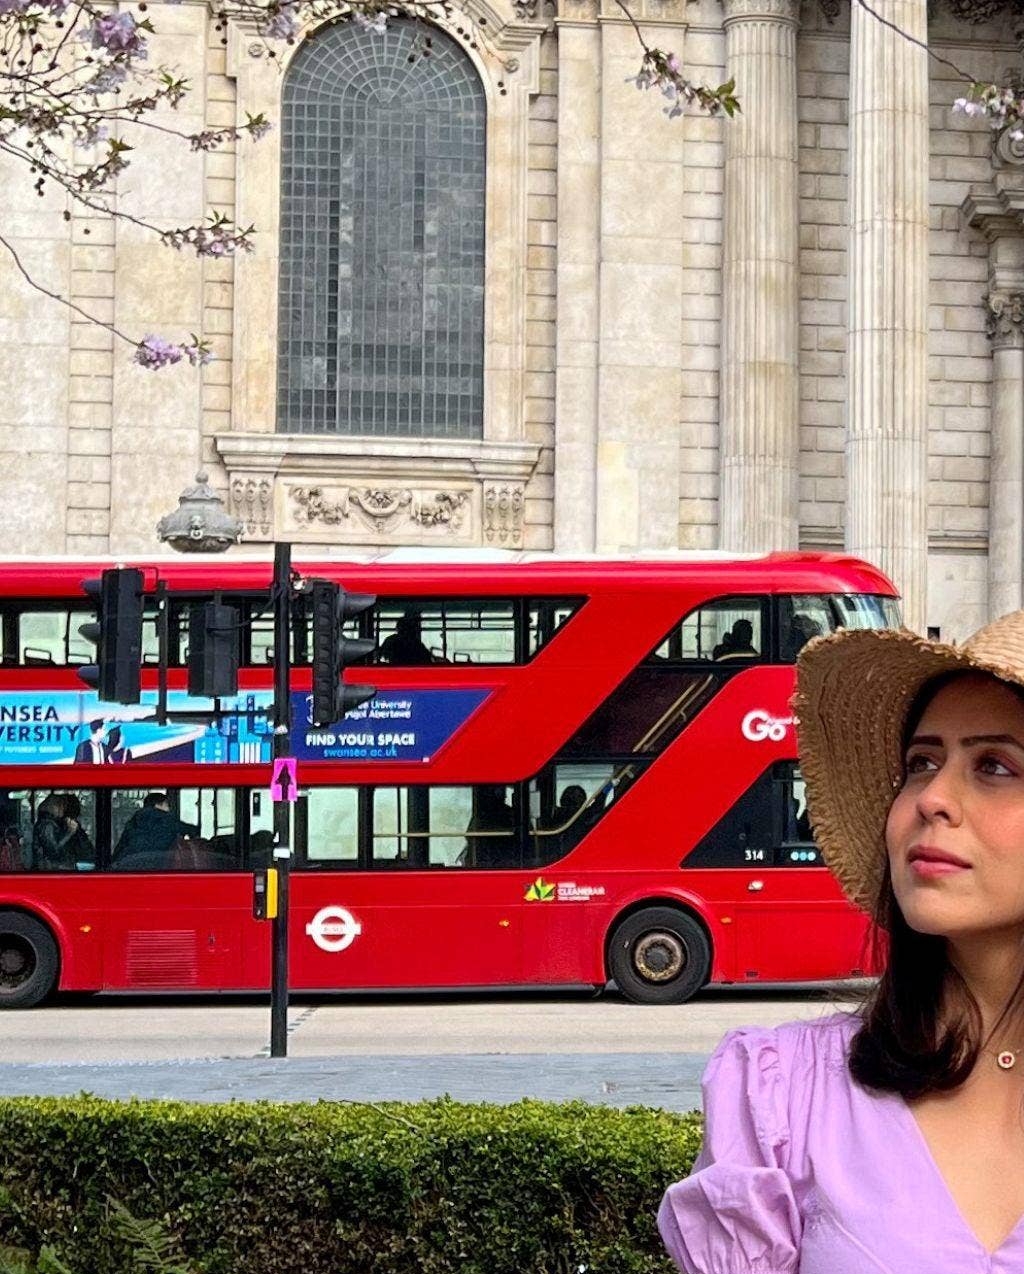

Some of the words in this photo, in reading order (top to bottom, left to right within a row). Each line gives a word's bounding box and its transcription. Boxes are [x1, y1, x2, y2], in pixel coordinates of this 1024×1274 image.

[371, 700, 411, 711] University
[368, 709, 411, 719] Abertawe
[741, 709, 787, 742] Go
[306, 733, 336, 746] FIND
[338, 733, 374, 746] YOUR
[378, 733, 415, 746] SPACE
[745, 849, 763, 861] 314
